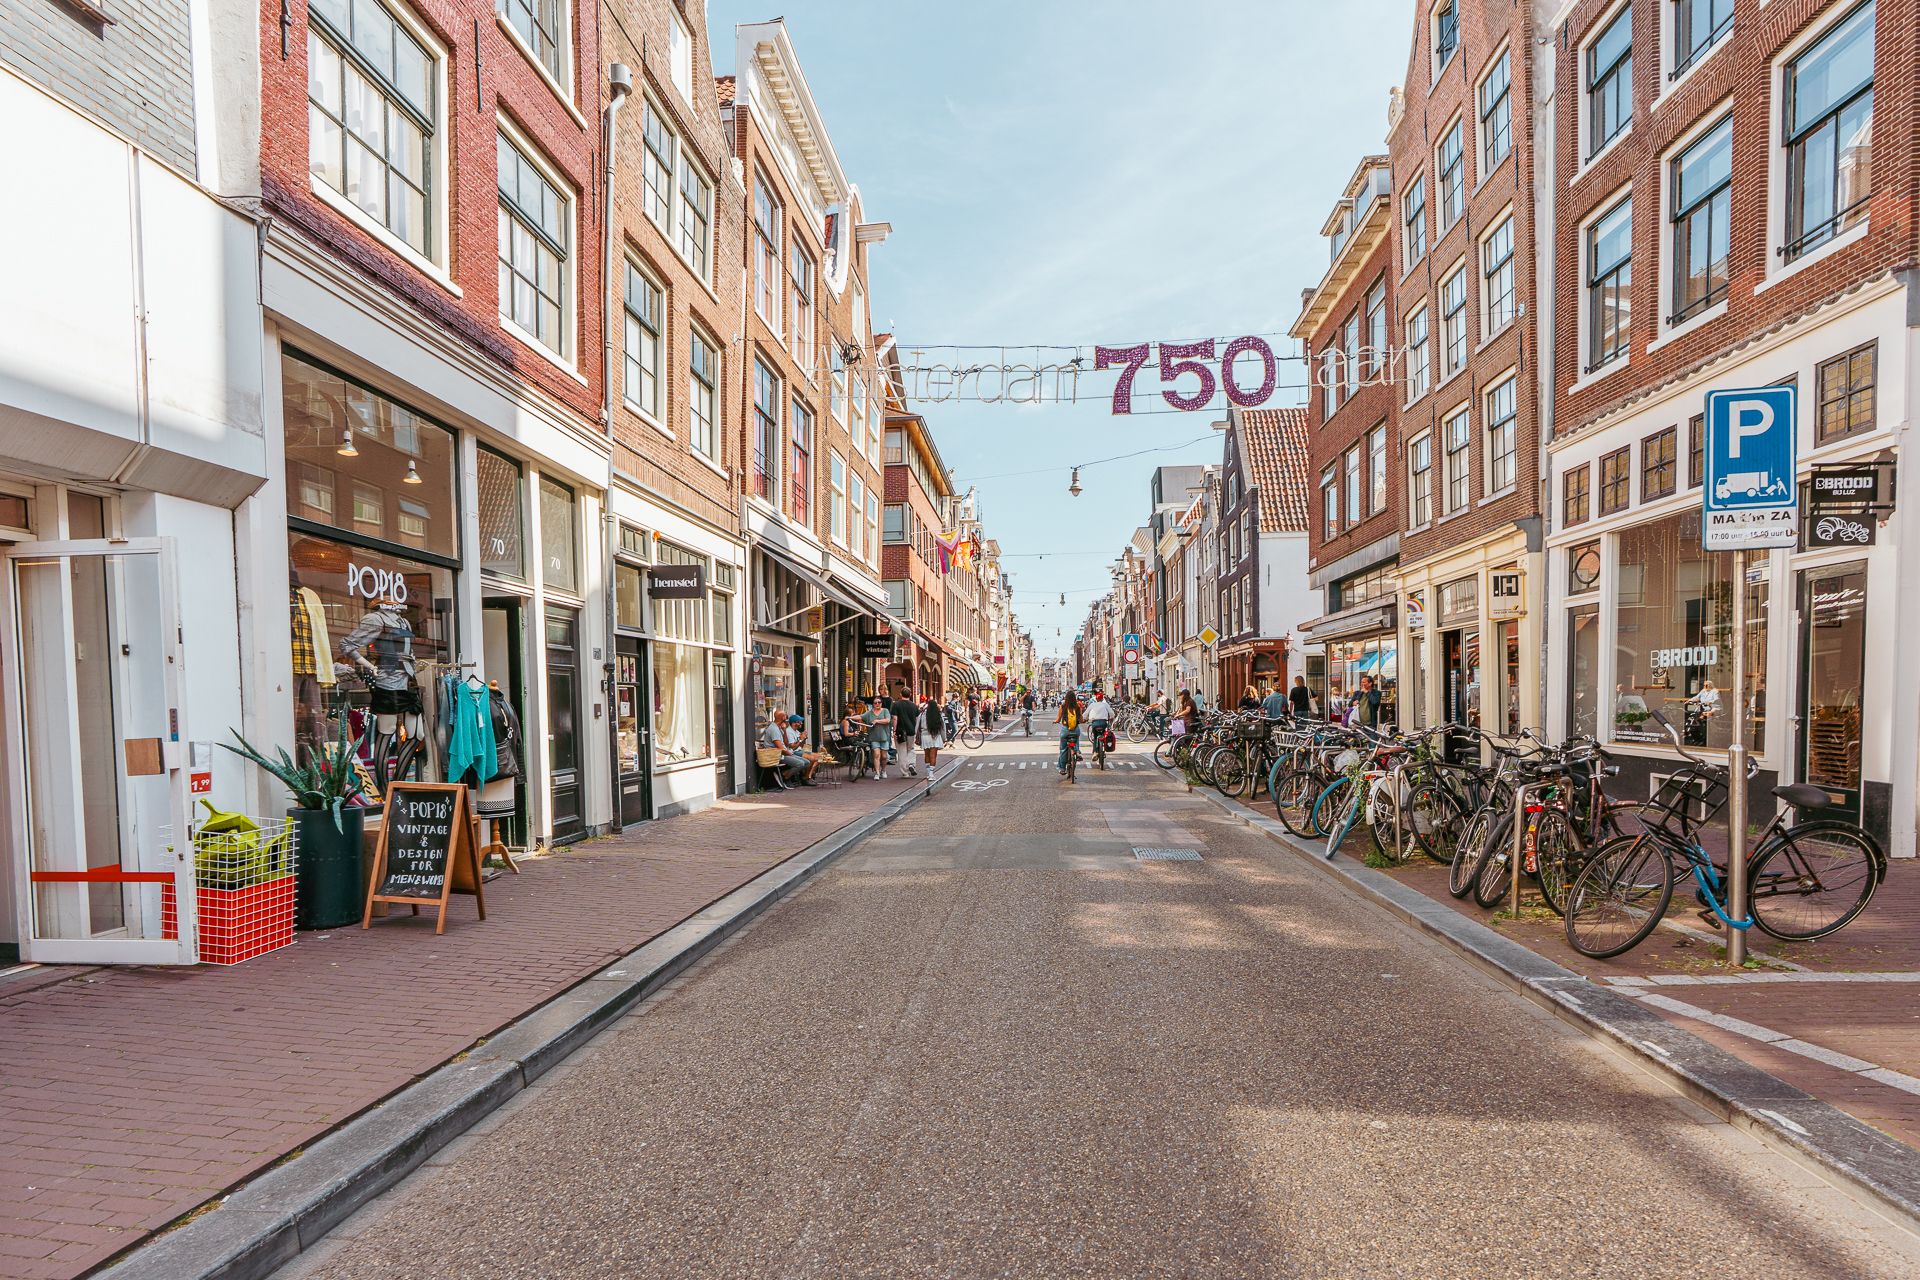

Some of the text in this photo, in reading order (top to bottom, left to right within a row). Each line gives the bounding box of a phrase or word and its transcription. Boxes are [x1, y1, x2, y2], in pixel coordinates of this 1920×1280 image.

[1094, 335, 1276, 415] 750
[1728, 399, 1775, 458] P
[1815, 476, 1873, 489] BBROOD
[1713, 514, 1736, 525] MA
[1770, 510, 1792, 521] ZA
[491, 537, 505, 556] 70
[550, 556, 561, 571] 70
[347, 562, 407, 604] POP18
[654, 577, 697, 588] hemsted
[1650, 645, 1717, 668] BBROOD
[191, 779, 210, 791] 1.99
[409, 801, 447, 819] POP18
[397, 824, 448, 835] VINTAGE
[420, 835, 428, 847] &
[398, 848, 443, 860] DESIGN
[411, 860, 433, 871] FOR
